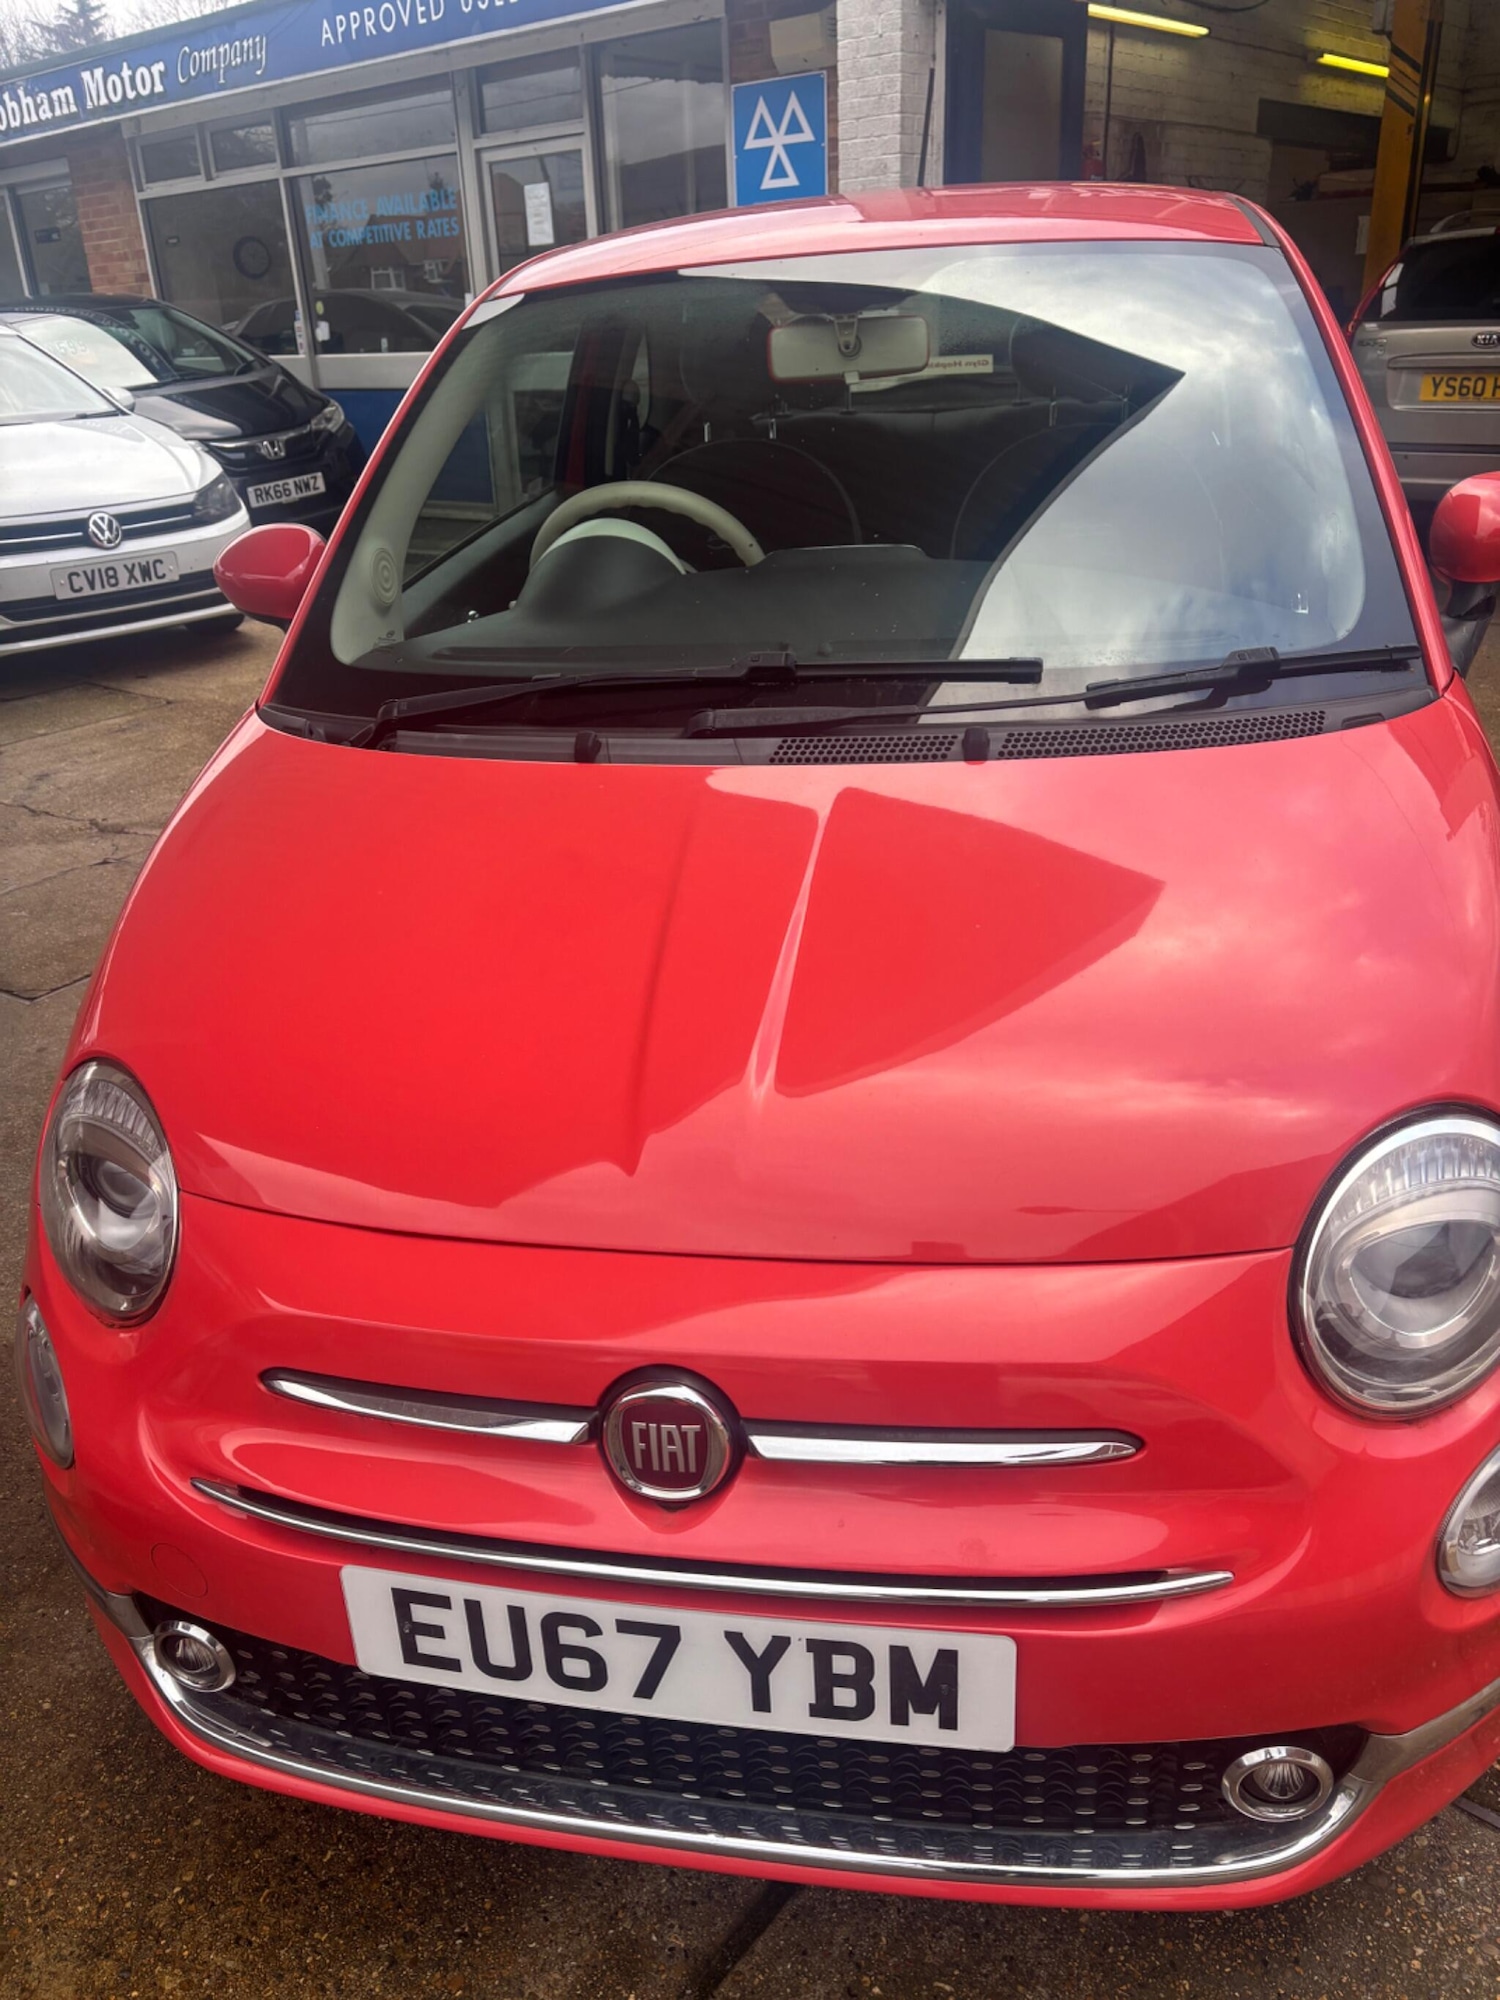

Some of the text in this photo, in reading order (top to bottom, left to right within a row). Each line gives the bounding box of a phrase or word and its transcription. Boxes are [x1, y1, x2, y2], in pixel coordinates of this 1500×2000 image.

[321, 0, 445, 47] APPROVED
[81, 60, 165, 109] Motor
[177, 34, 267, 84] Company
[305, 187, 458, 225] FINANCE AVAILABLE
[309, 216, 460, 250] AT COMPETITIVE RATES
[1476, 333, 1498, 345] KIA
[1432, 376, 1486, 398] YS60
[254, 475, 320, 504] RK66 NWZ
[67, 559, 166, 594] CV18 XWC
[631, 1421, 701, 1473] FIAT
[391, 1586, 959, 1731] EU67 YBM
